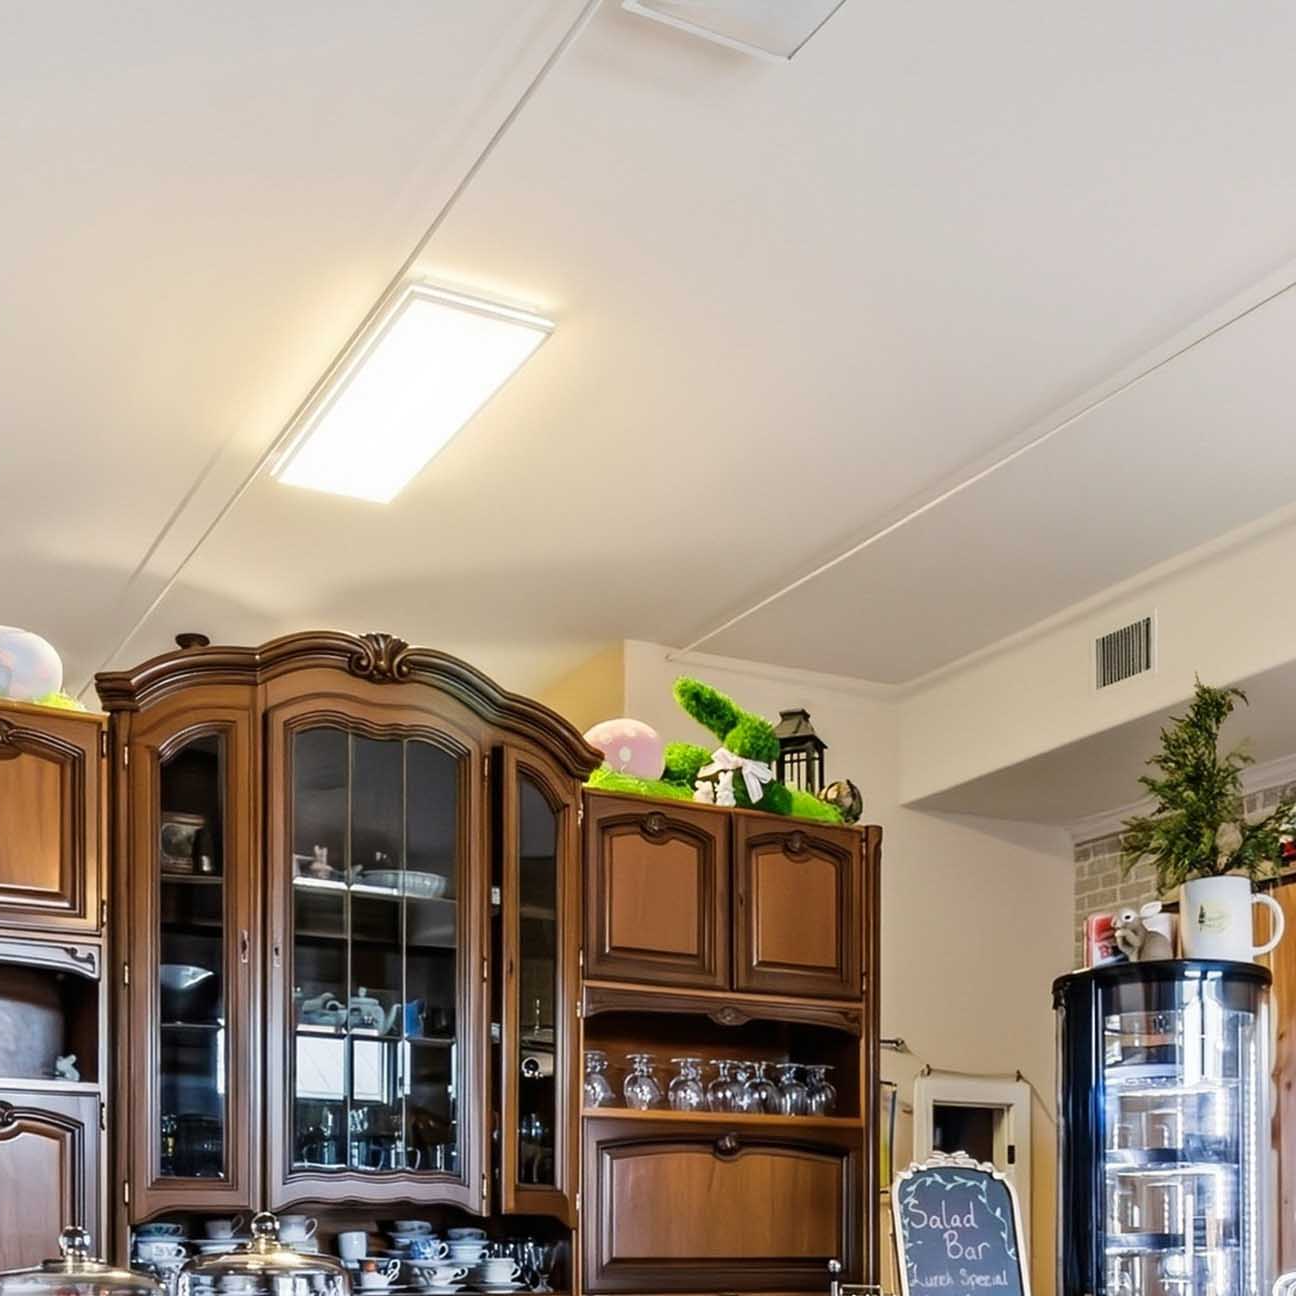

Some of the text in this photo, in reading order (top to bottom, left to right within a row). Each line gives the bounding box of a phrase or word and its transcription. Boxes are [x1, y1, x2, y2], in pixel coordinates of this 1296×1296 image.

[908, 1199, 978, 1230] Salad
[943, 1230, 991, 1260] Bar
[910, 1264, 1009, 1289] Lunch Special
